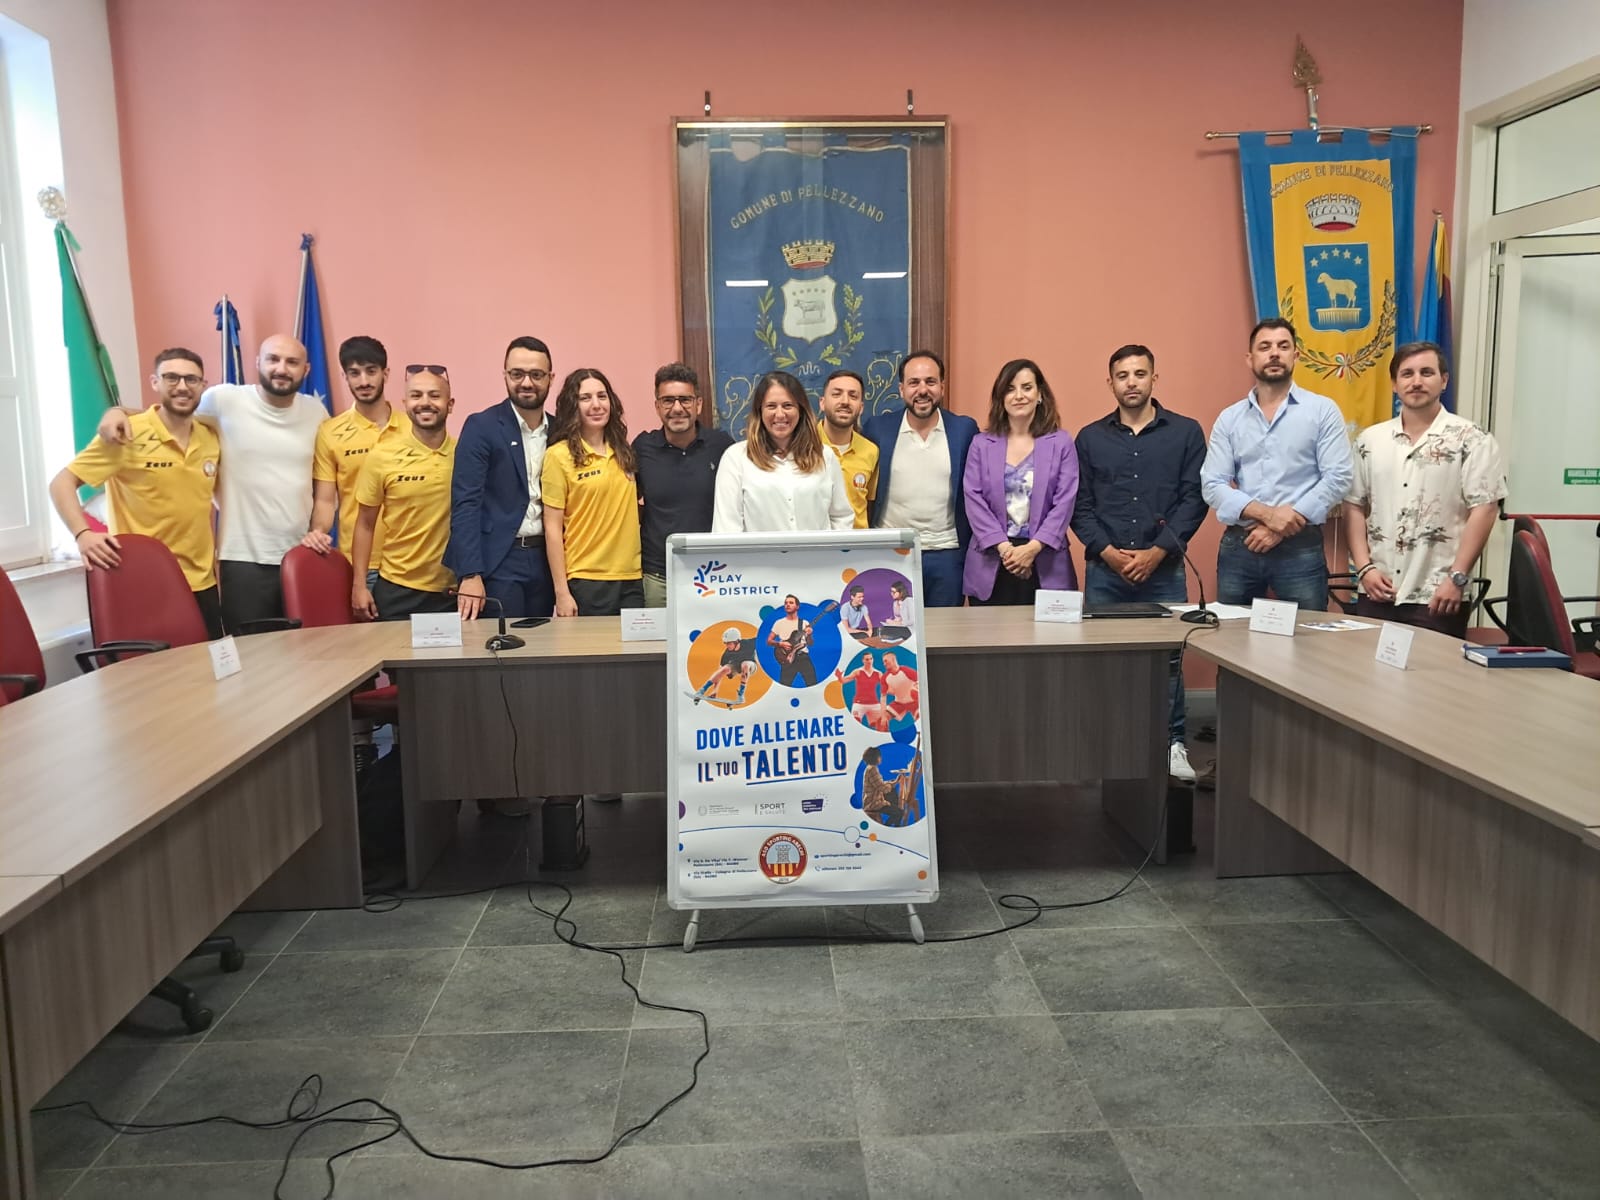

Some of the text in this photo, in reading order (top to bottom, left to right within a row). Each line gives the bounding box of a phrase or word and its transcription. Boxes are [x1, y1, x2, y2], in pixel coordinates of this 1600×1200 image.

[1270, 164, 1394, 198] COMUNE DI PELLEZZANO
[730, 183, 885, 229] COMUNE DI PELLEZZANO
[710, 574, 742, 583] PLAY
[719, 585, 779, 596] DISTRICT
[696, 715, 845, 750] DOVE ALLENARE
[697, 741, 848, 783] IL TUO TALENTO
[760, 802, 785, 810] SPORT
[766, 835, 792, 846] SPORTING
